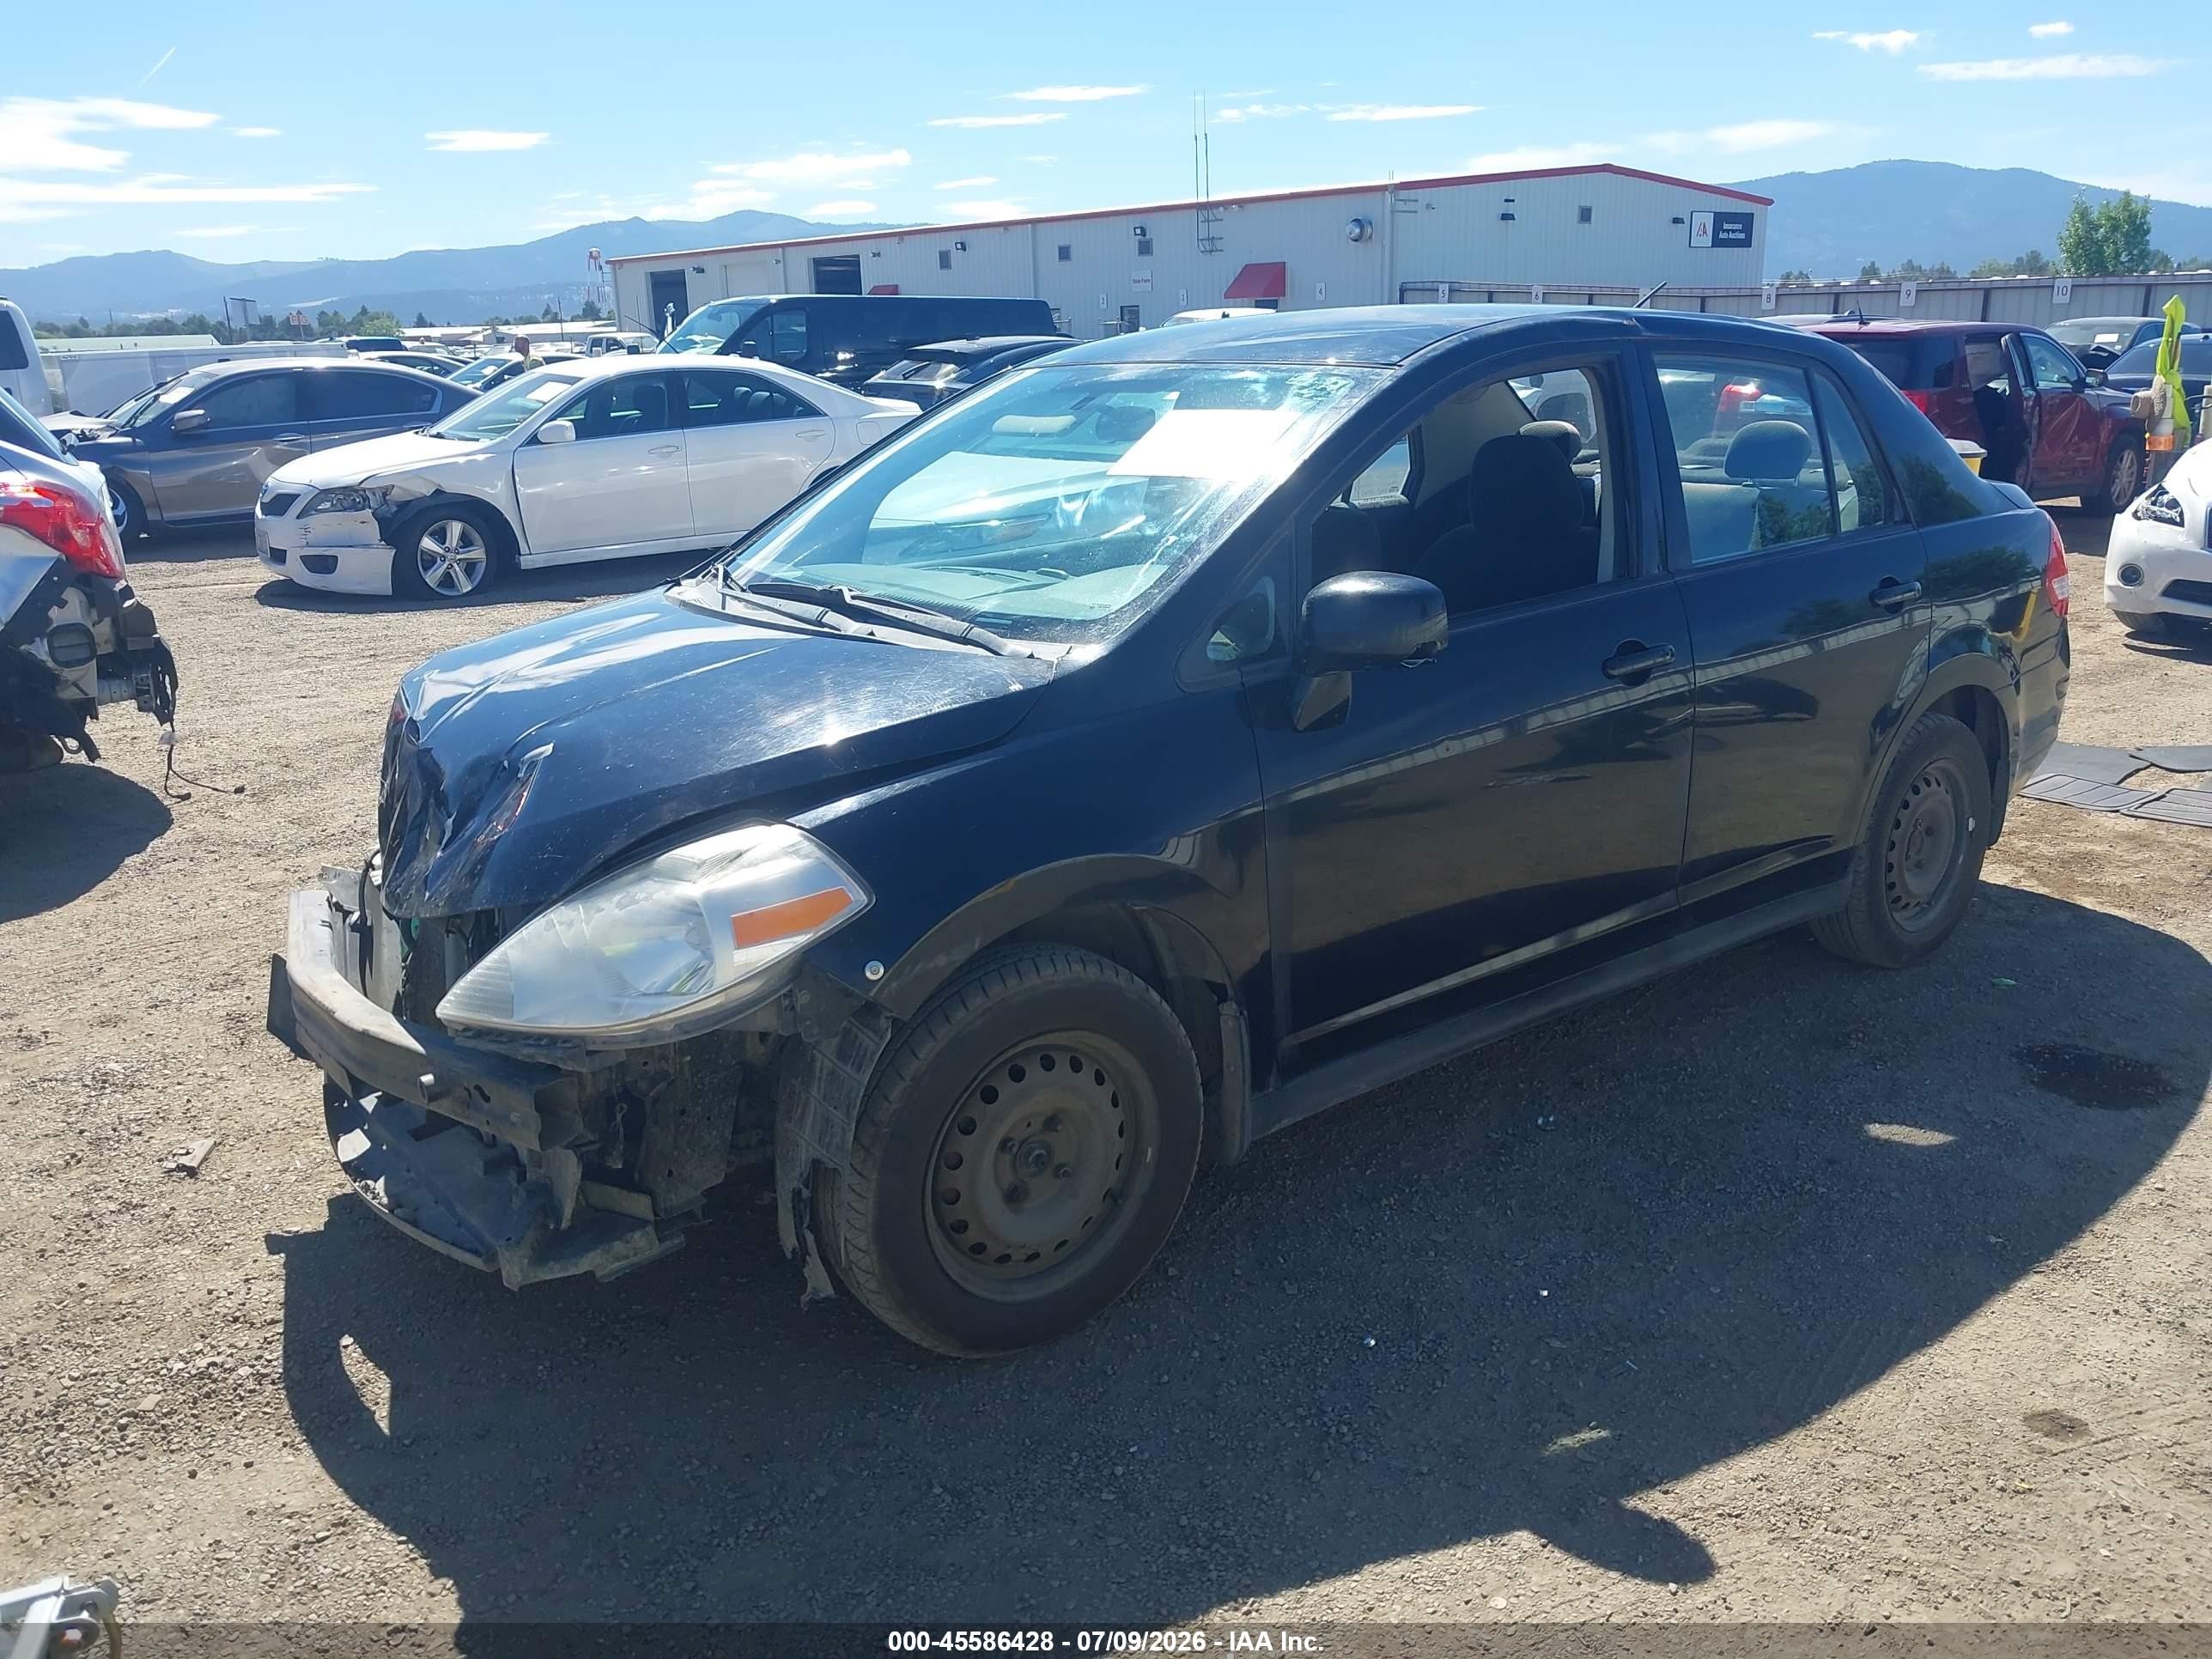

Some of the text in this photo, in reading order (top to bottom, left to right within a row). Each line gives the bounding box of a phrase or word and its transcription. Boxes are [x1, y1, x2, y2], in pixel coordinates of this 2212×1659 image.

[1441, 289, 1446, 299] 5
[1905, 289, 1911, 300] 9
[2057, 285, 2068, 296] 10
[1534, 291, 1540, 301] 6
[1765, 294, 1771, 303] 8
